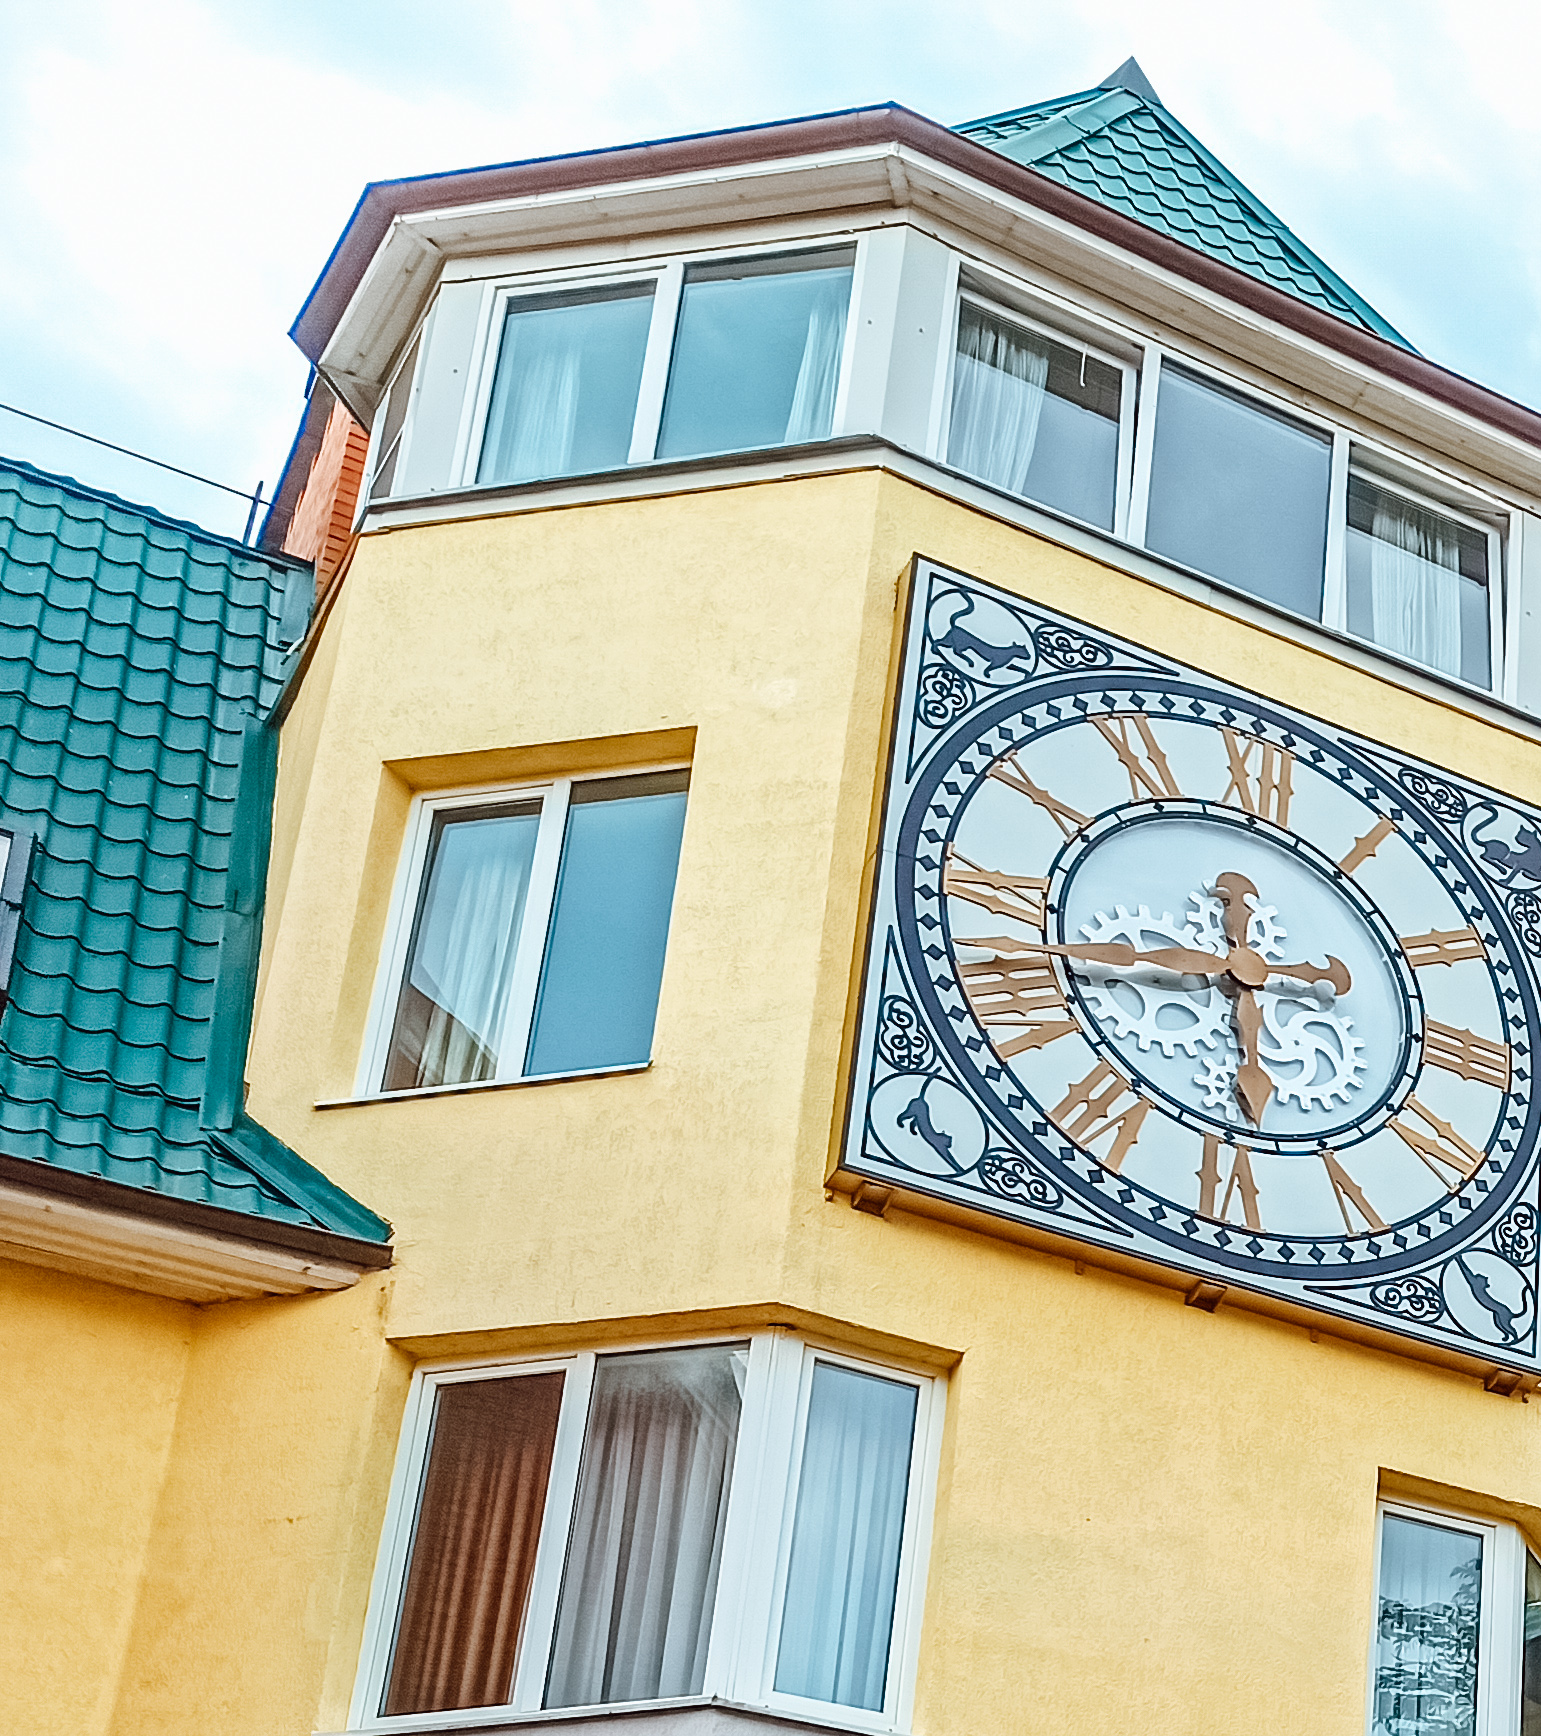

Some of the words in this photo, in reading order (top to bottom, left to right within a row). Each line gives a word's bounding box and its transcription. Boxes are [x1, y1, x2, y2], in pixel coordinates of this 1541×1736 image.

[985, 748, 1096, 845] X
[1086, 711, 1185, 804] XI
[1217, 724, 1297, 832] XII
[942, 841, 1051, 931] IX
[1337, 813, 1400, 879] I
[1398, 922, 1489, 968] II
[953, 954, 1083, 1064] VIII
[1421, 1013, 1513, 1093] III
[1043, 1055, 1157, 1177] VII
[1384, 1092, 1488, 1194] IV
[1194, 1131, 1267, 1234] VI
[1317, 1149, 1392, 1238] V
